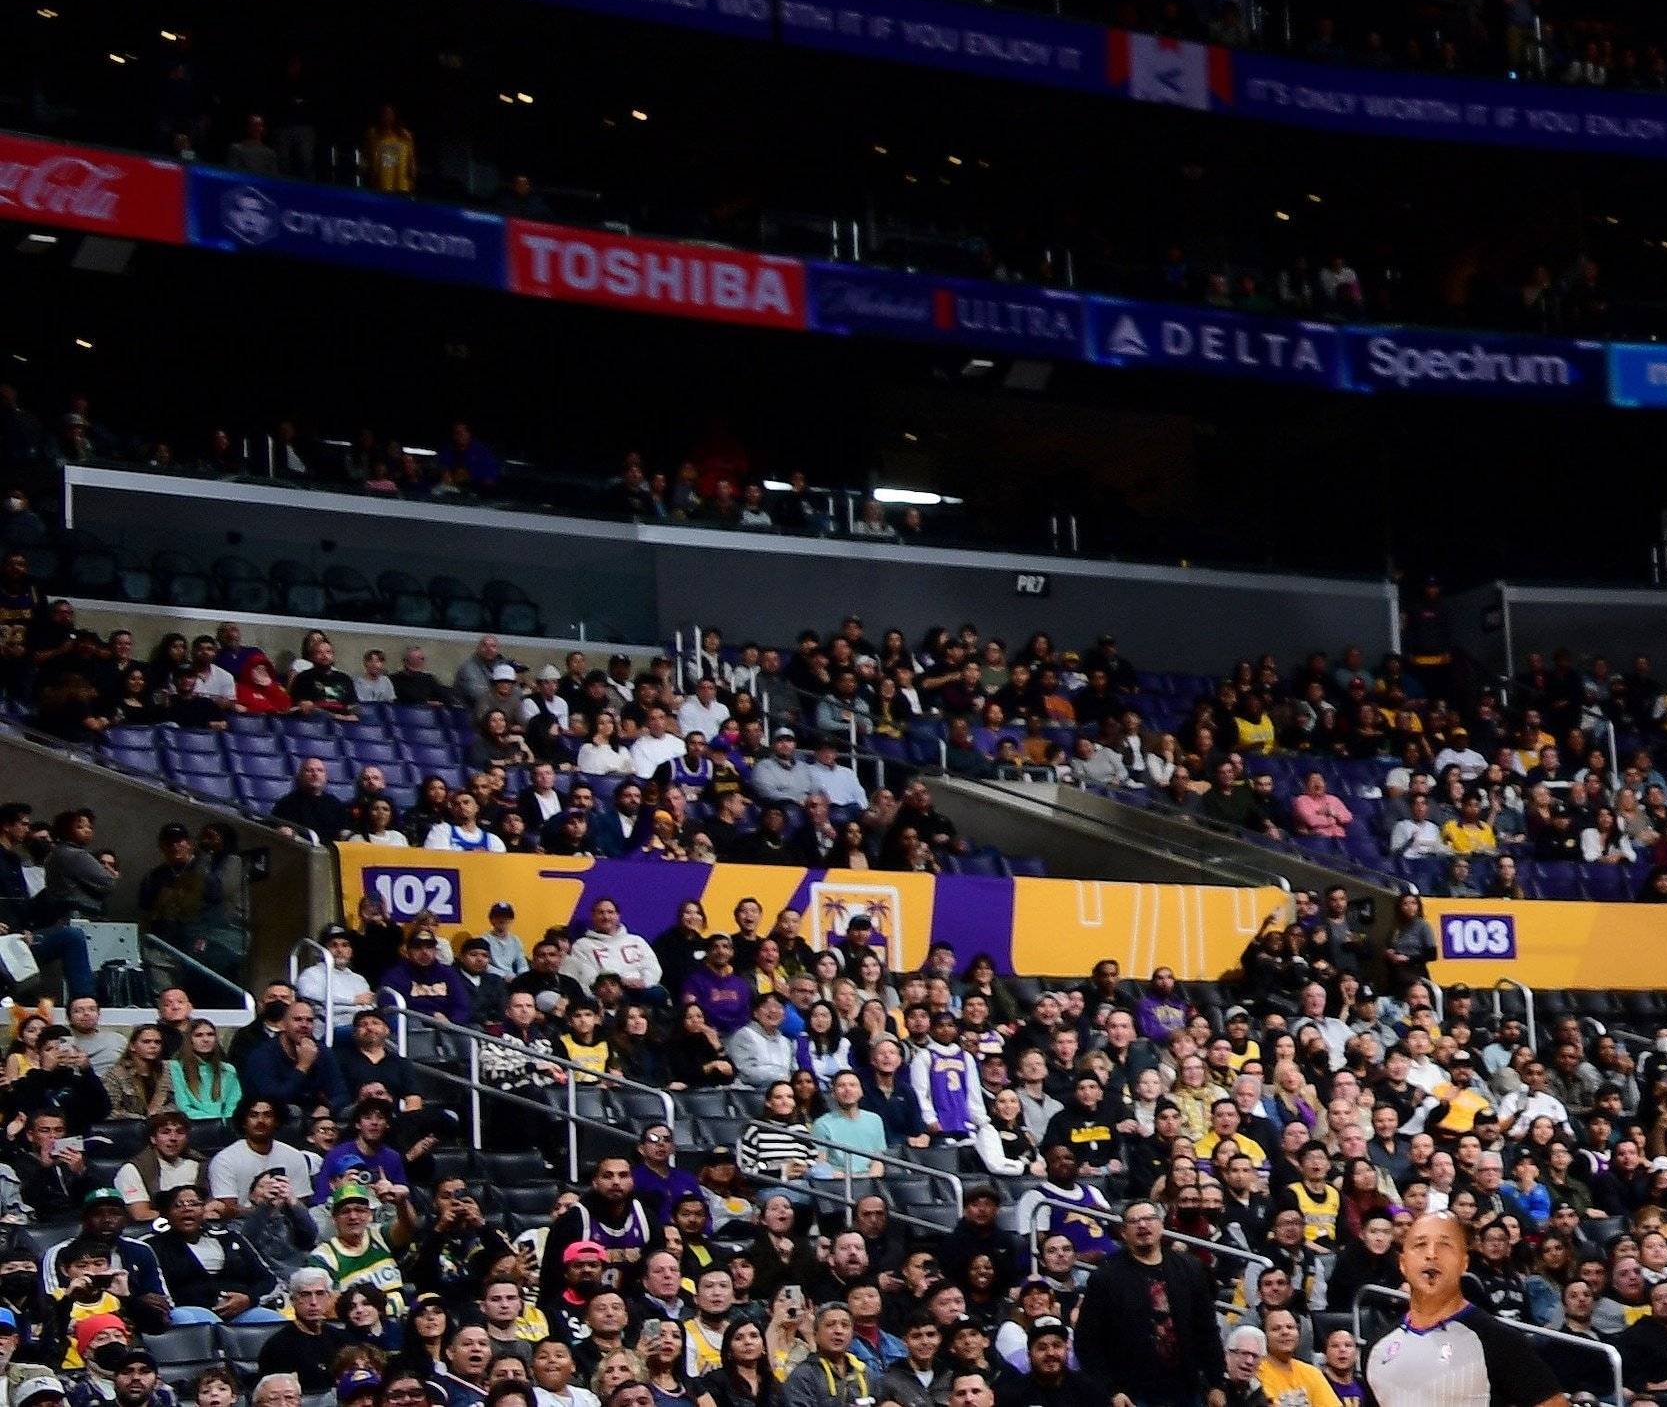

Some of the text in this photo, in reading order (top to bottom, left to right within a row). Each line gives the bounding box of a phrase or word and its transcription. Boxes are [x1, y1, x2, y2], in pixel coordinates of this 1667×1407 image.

[280, 209, 477, 261] crypto.com
[519, 233, 793, 315] TOSHIBA
[955, 295, 1077, 340] ULTRA
[1158, 320, 1325, 373] DELTA
[1367, 334, 1571, 388] Spectrum
[375, 874, 454, 916] 102
[1447, 918, 1511, 956] 103
